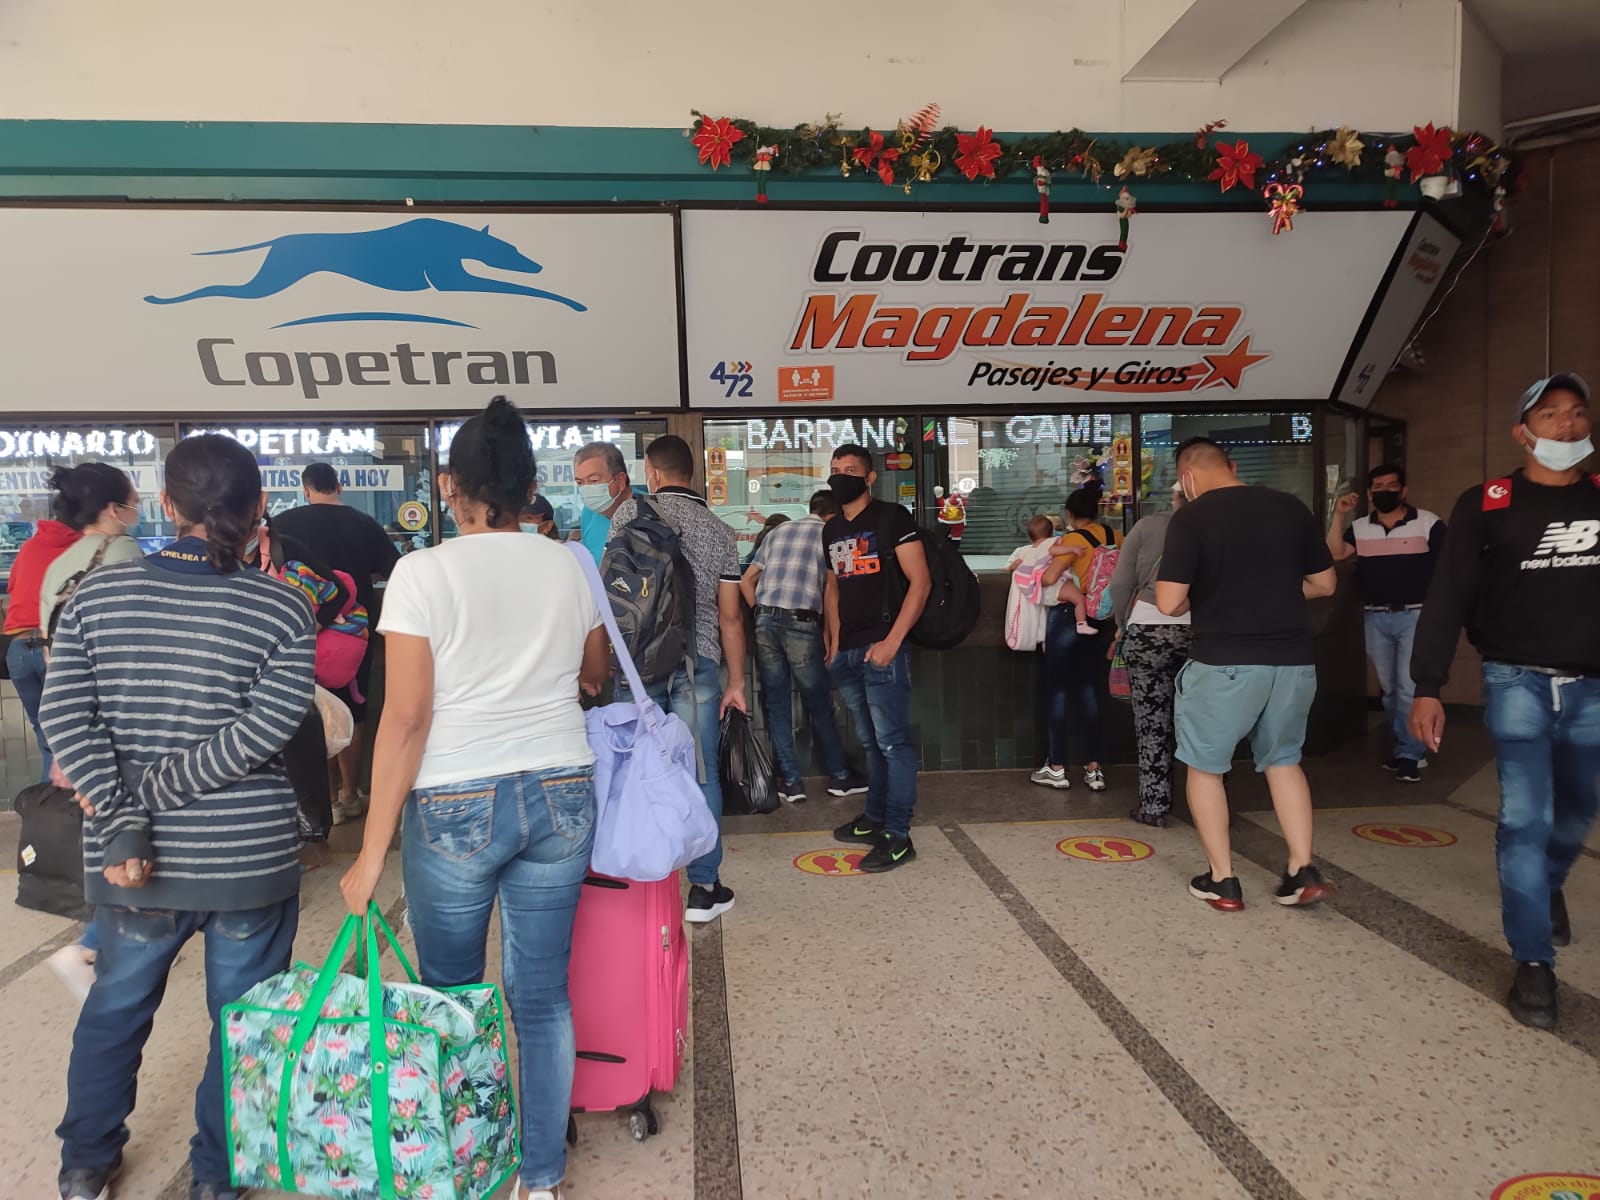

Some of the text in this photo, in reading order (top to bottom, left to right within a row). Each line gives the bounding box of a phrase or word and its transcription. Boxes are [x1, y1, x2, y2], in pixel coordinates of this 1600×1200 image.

[811, 230, 1127, 283] Cootrans
[790, 293, 1243, 361] Magdalena
[196, 337, 559, 399] Copetran
[710, 361, 754, 398] 472
[967, 360, 1192, 391] Pasajes y Giros
[189, 428, 376, 455] PETRAN
[260, 469, 301, 488] NTAS
[355, 468, 391, 488] HOY
[552, 463, 576, 484] PA
[160, 549, 209, 562] CHELSEA F
[1520, 553, 1600, 571] new balanc
